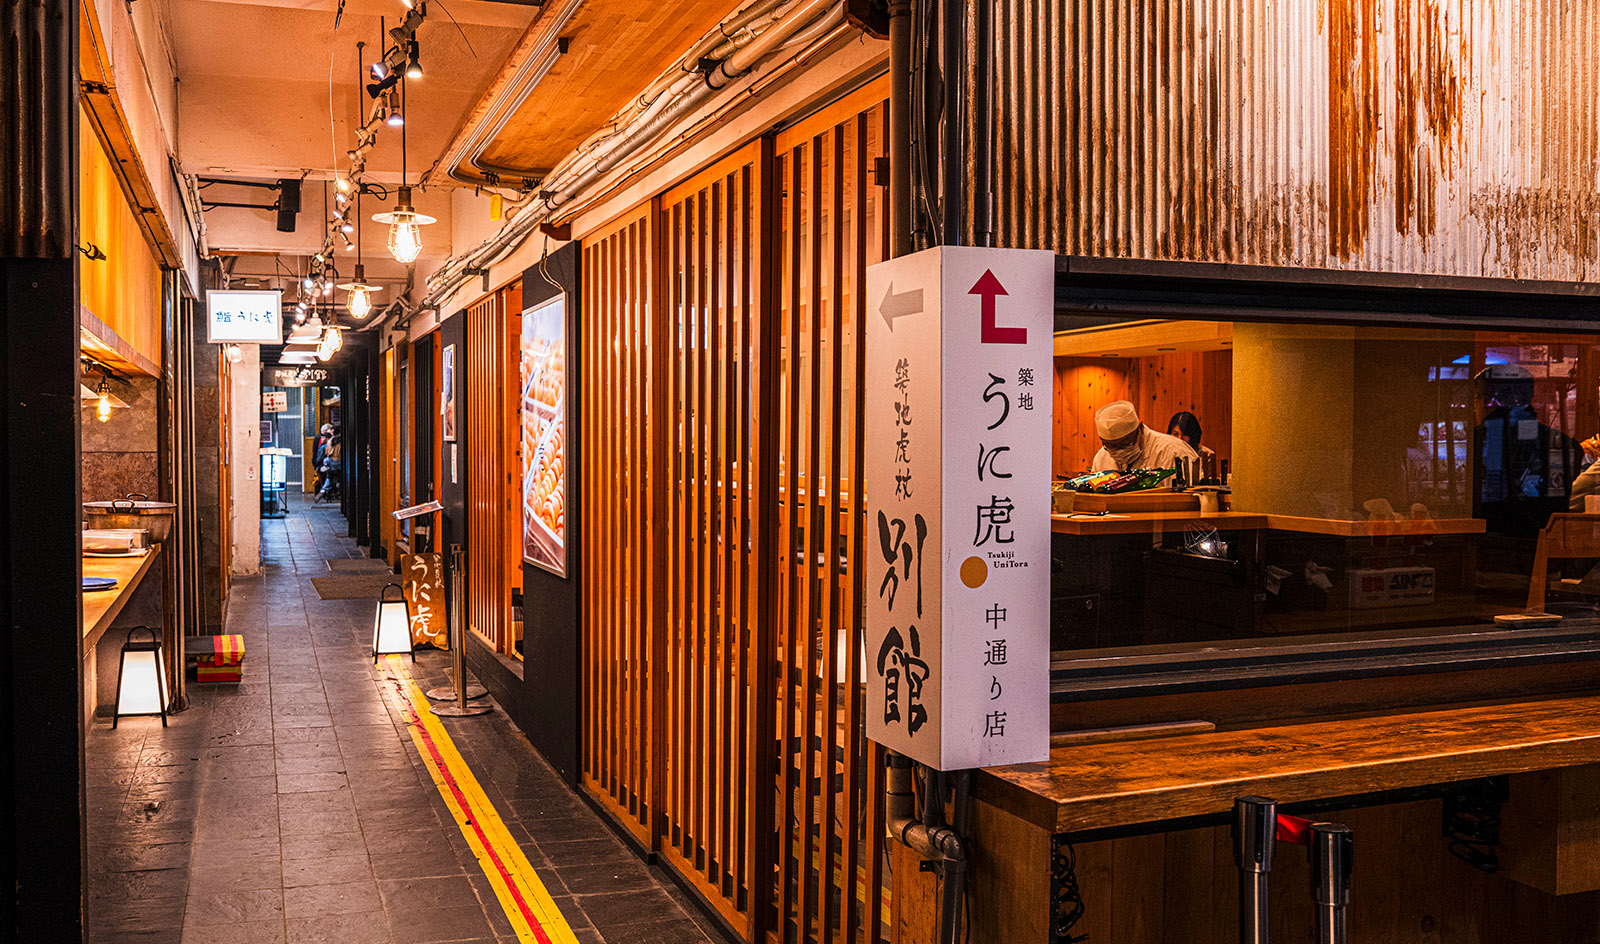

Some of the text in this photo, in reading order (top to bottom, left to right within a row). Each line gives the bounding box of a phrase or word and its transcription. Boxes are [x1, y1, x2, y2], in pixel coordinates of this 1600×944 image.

[1018, 367, 1035, 411] 築地
[973, 372, 1016, 547] うに虎
[410, 555, 441, 637] うに虎
[987, 551, 1015, 560] Tsukiji
[993, 560, 1029, 569] UniTora
[878, 509, 930, 737] 別館
[982, 603, 1009, 740] 中通り店
